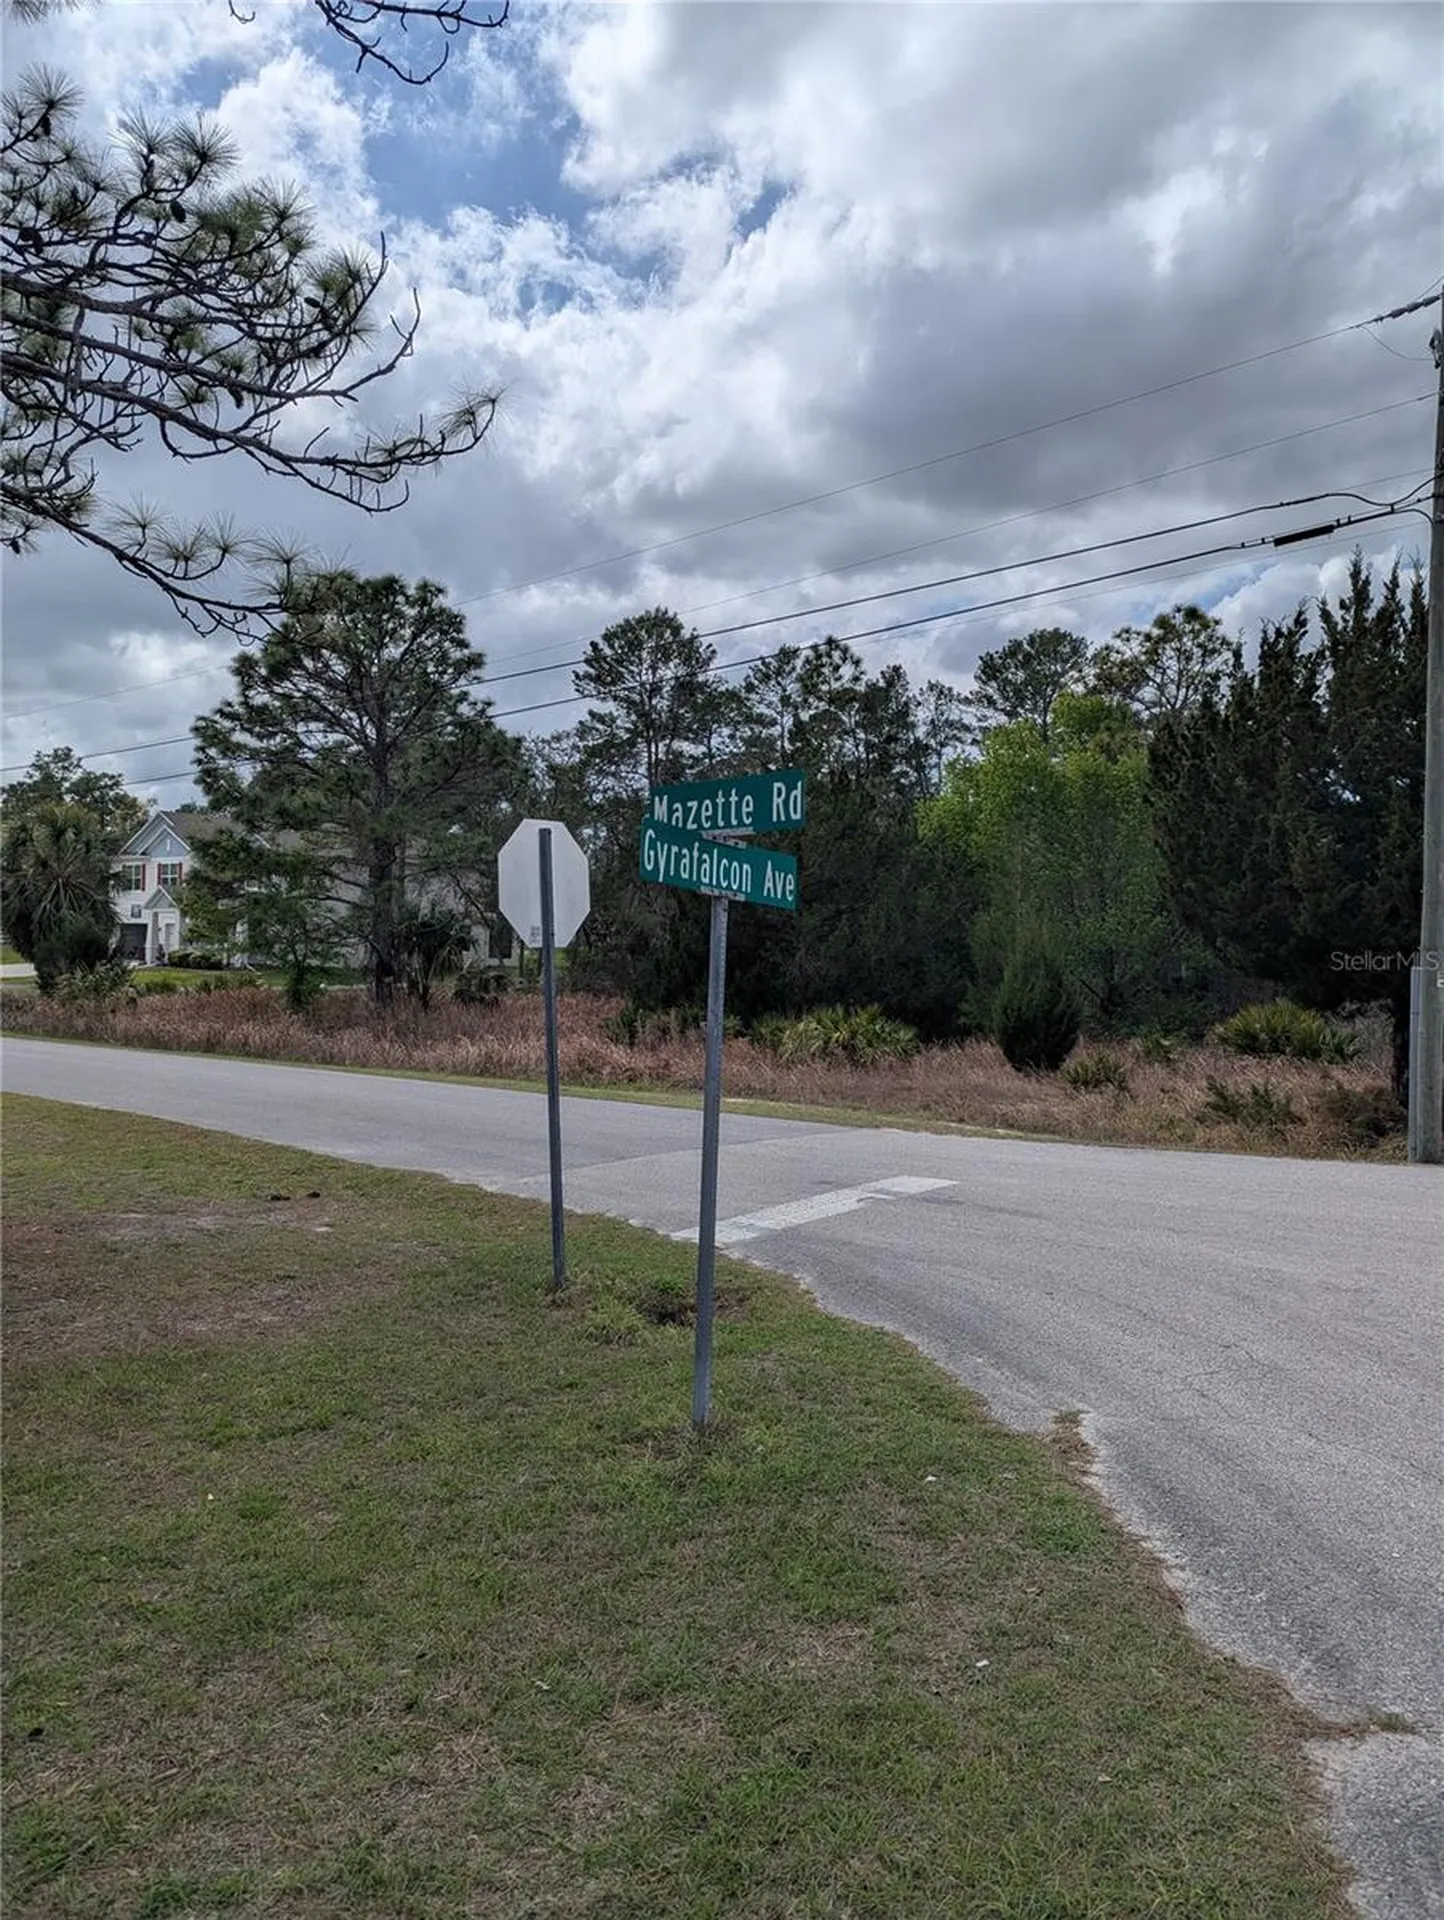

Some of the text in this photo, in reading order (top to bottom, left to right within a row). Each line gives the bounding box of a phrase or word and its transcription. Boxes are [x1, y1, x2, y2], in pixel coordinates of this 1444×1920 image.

[653, 780, 802, 829] Mazette Rd
[643, 828, 795, 901] Gyrafalcon Ave
